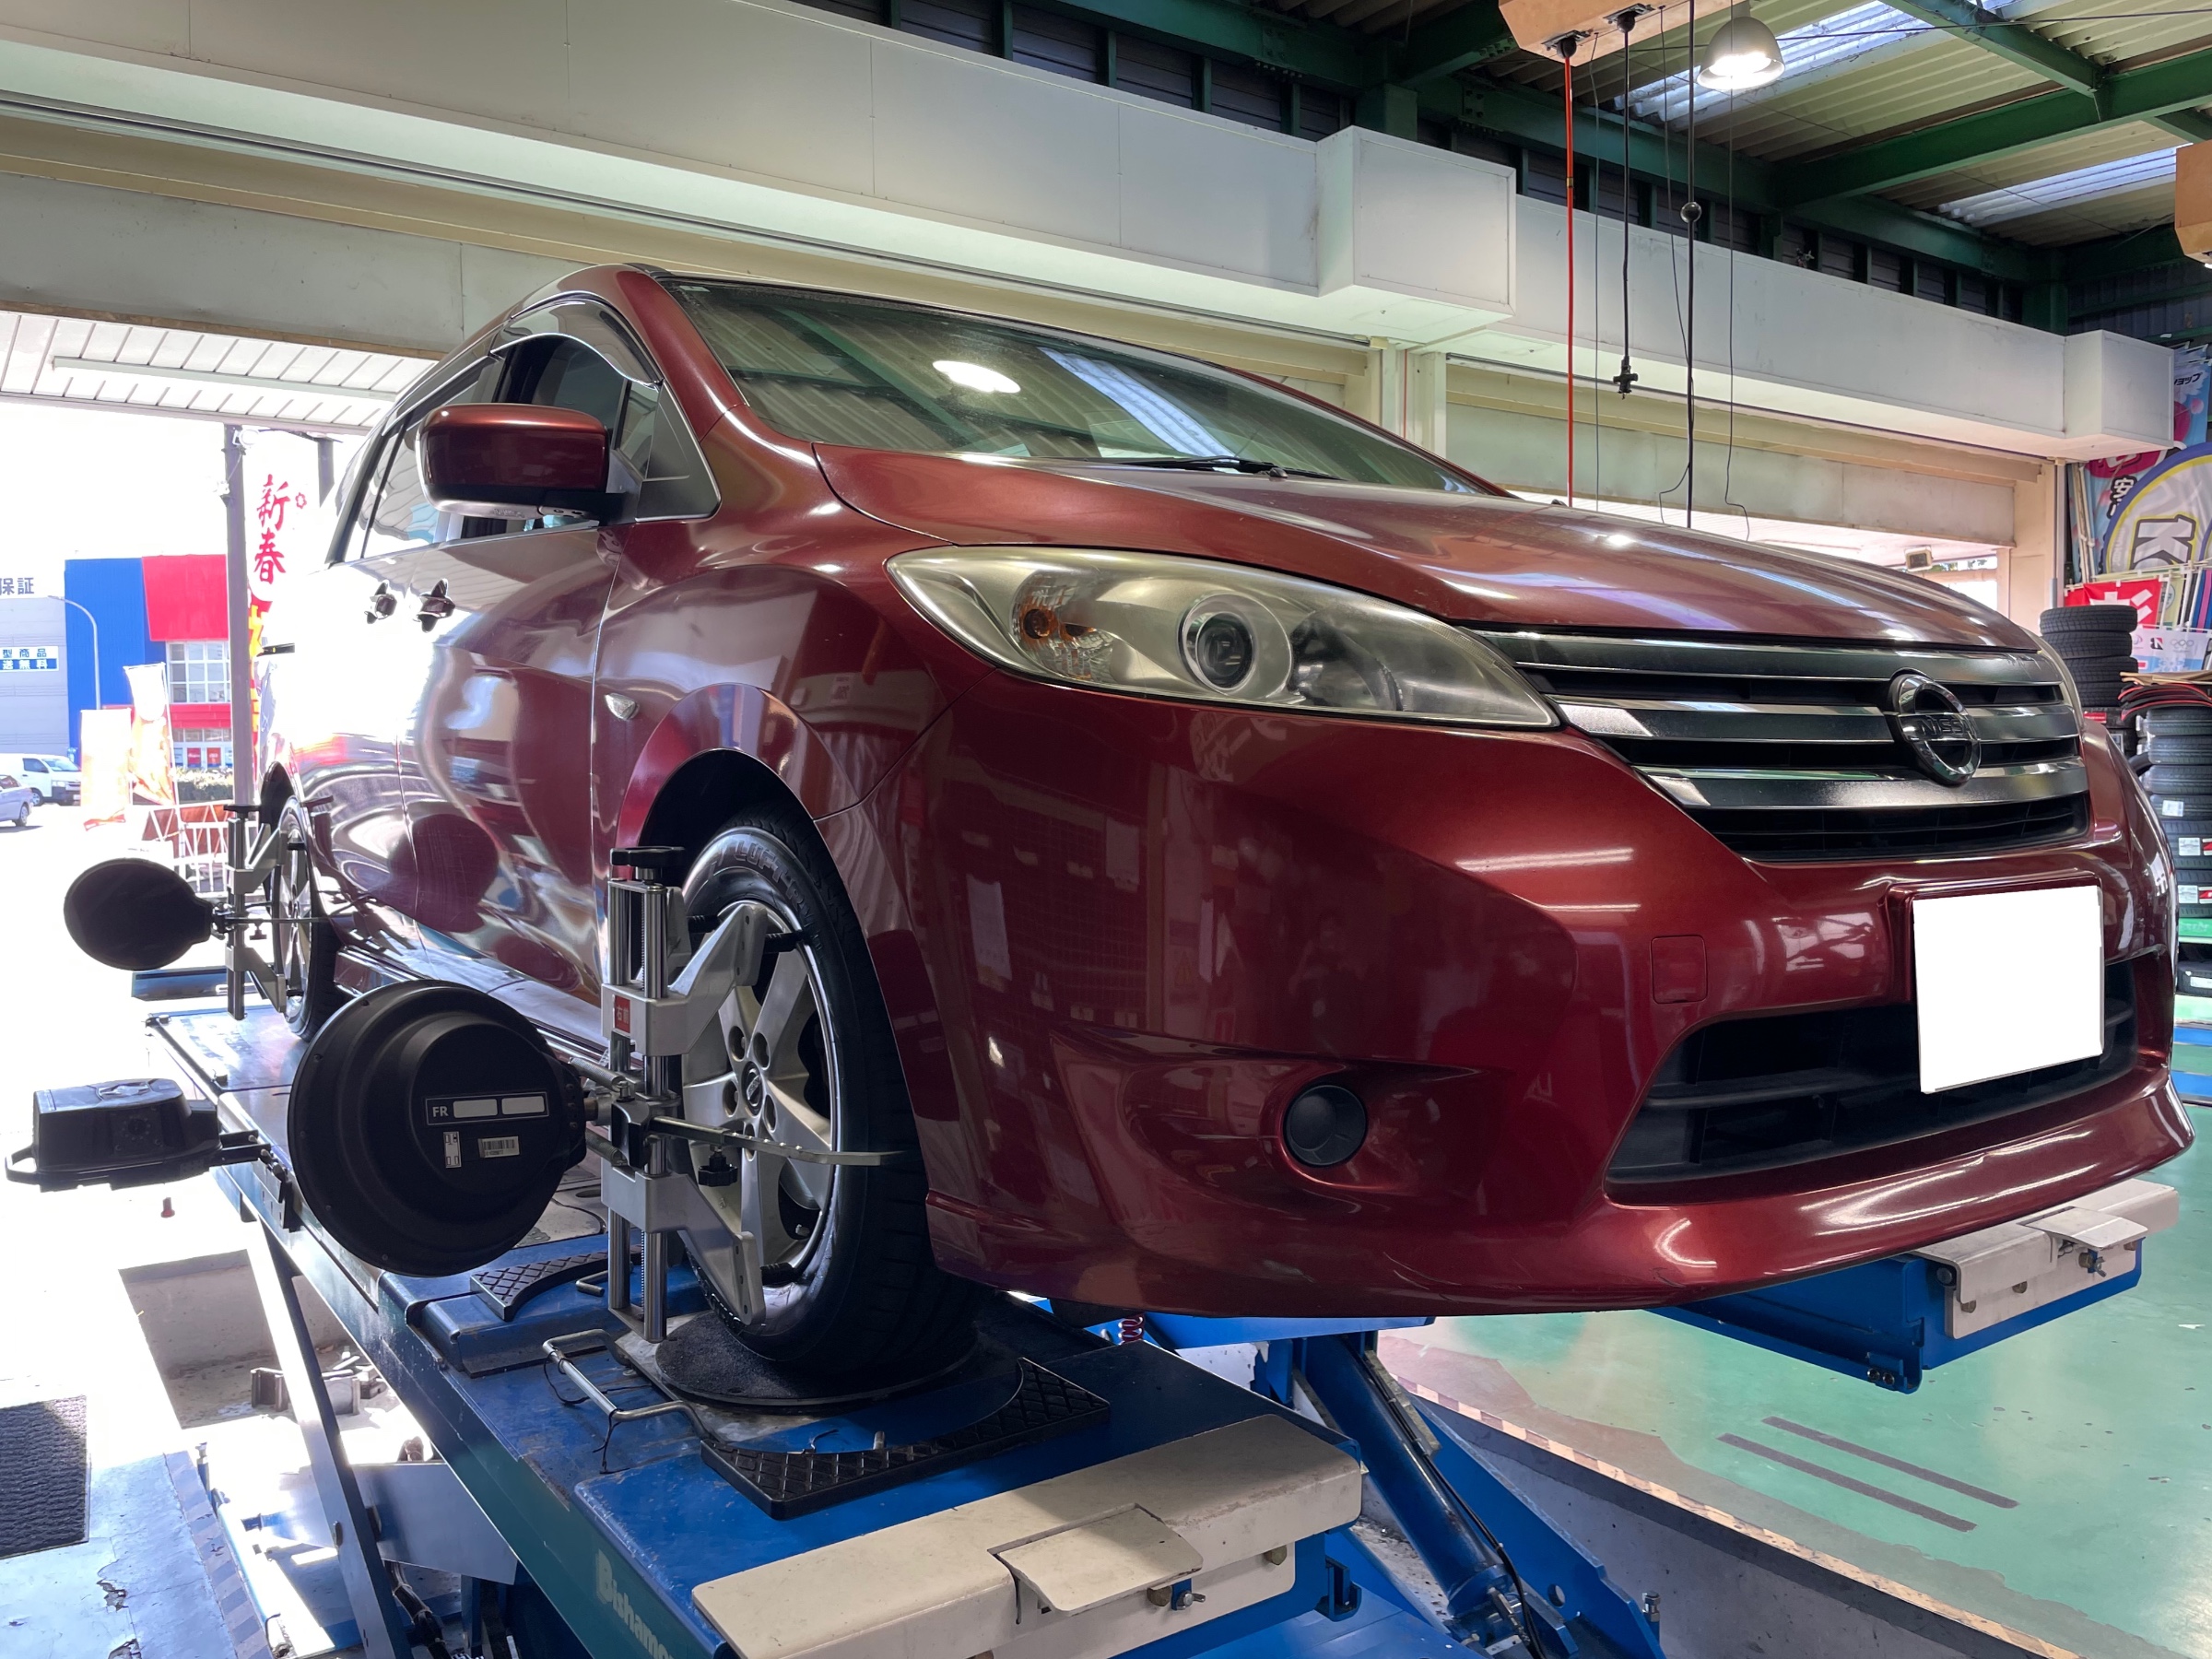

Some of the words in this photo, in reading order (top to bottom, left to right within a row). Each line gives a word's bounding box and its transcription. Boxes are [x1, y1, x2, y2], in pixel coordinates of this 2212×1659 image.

[2174, 372, 2203, 385] ョップ
[254, 474, 290, 584] 新春
[0, 577, 34, 595] 保証
[1918, 718, 1968, 736] NISS
[617, 1005, 629, 1025] 右前
[432, 1106, 449, 1117] FR
[595, 1548, 675, 1659] Bishamo
